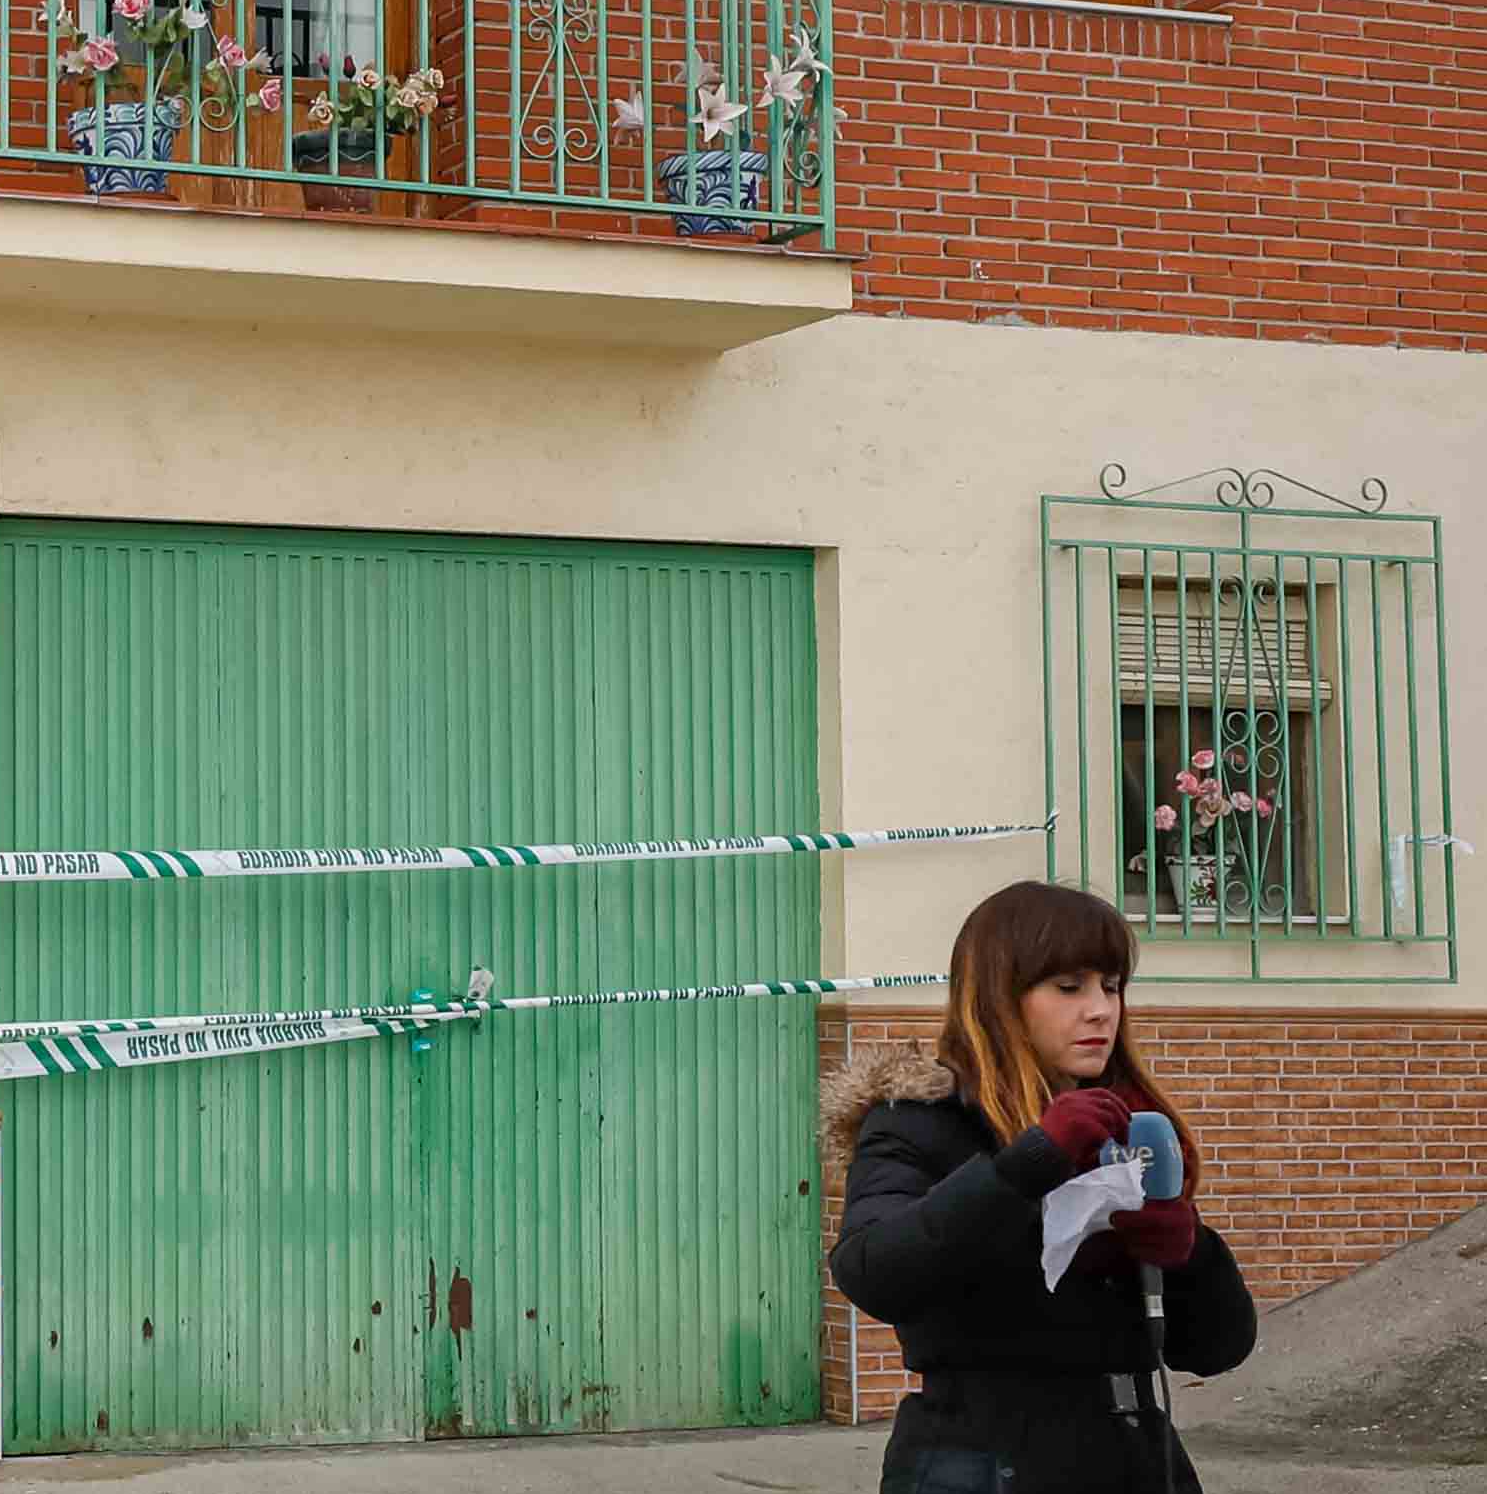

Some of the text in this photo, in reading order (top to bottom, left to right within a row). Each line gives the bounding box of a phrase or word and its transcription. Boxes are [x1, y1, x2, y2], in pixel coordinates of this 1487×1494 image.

[15, 854, 38, 876] NO
[44, 853, 100, 875] PASAR
[236, 850, 312, 869] GUARDIA
[315, 849, 358, 868] CIVIL
[363, 848, 386, 866] NO
[127, 1021, 327, 1059] GUARDIA CIVIL NO PASAR
[1110, 1146, 1155, 1165] tve
